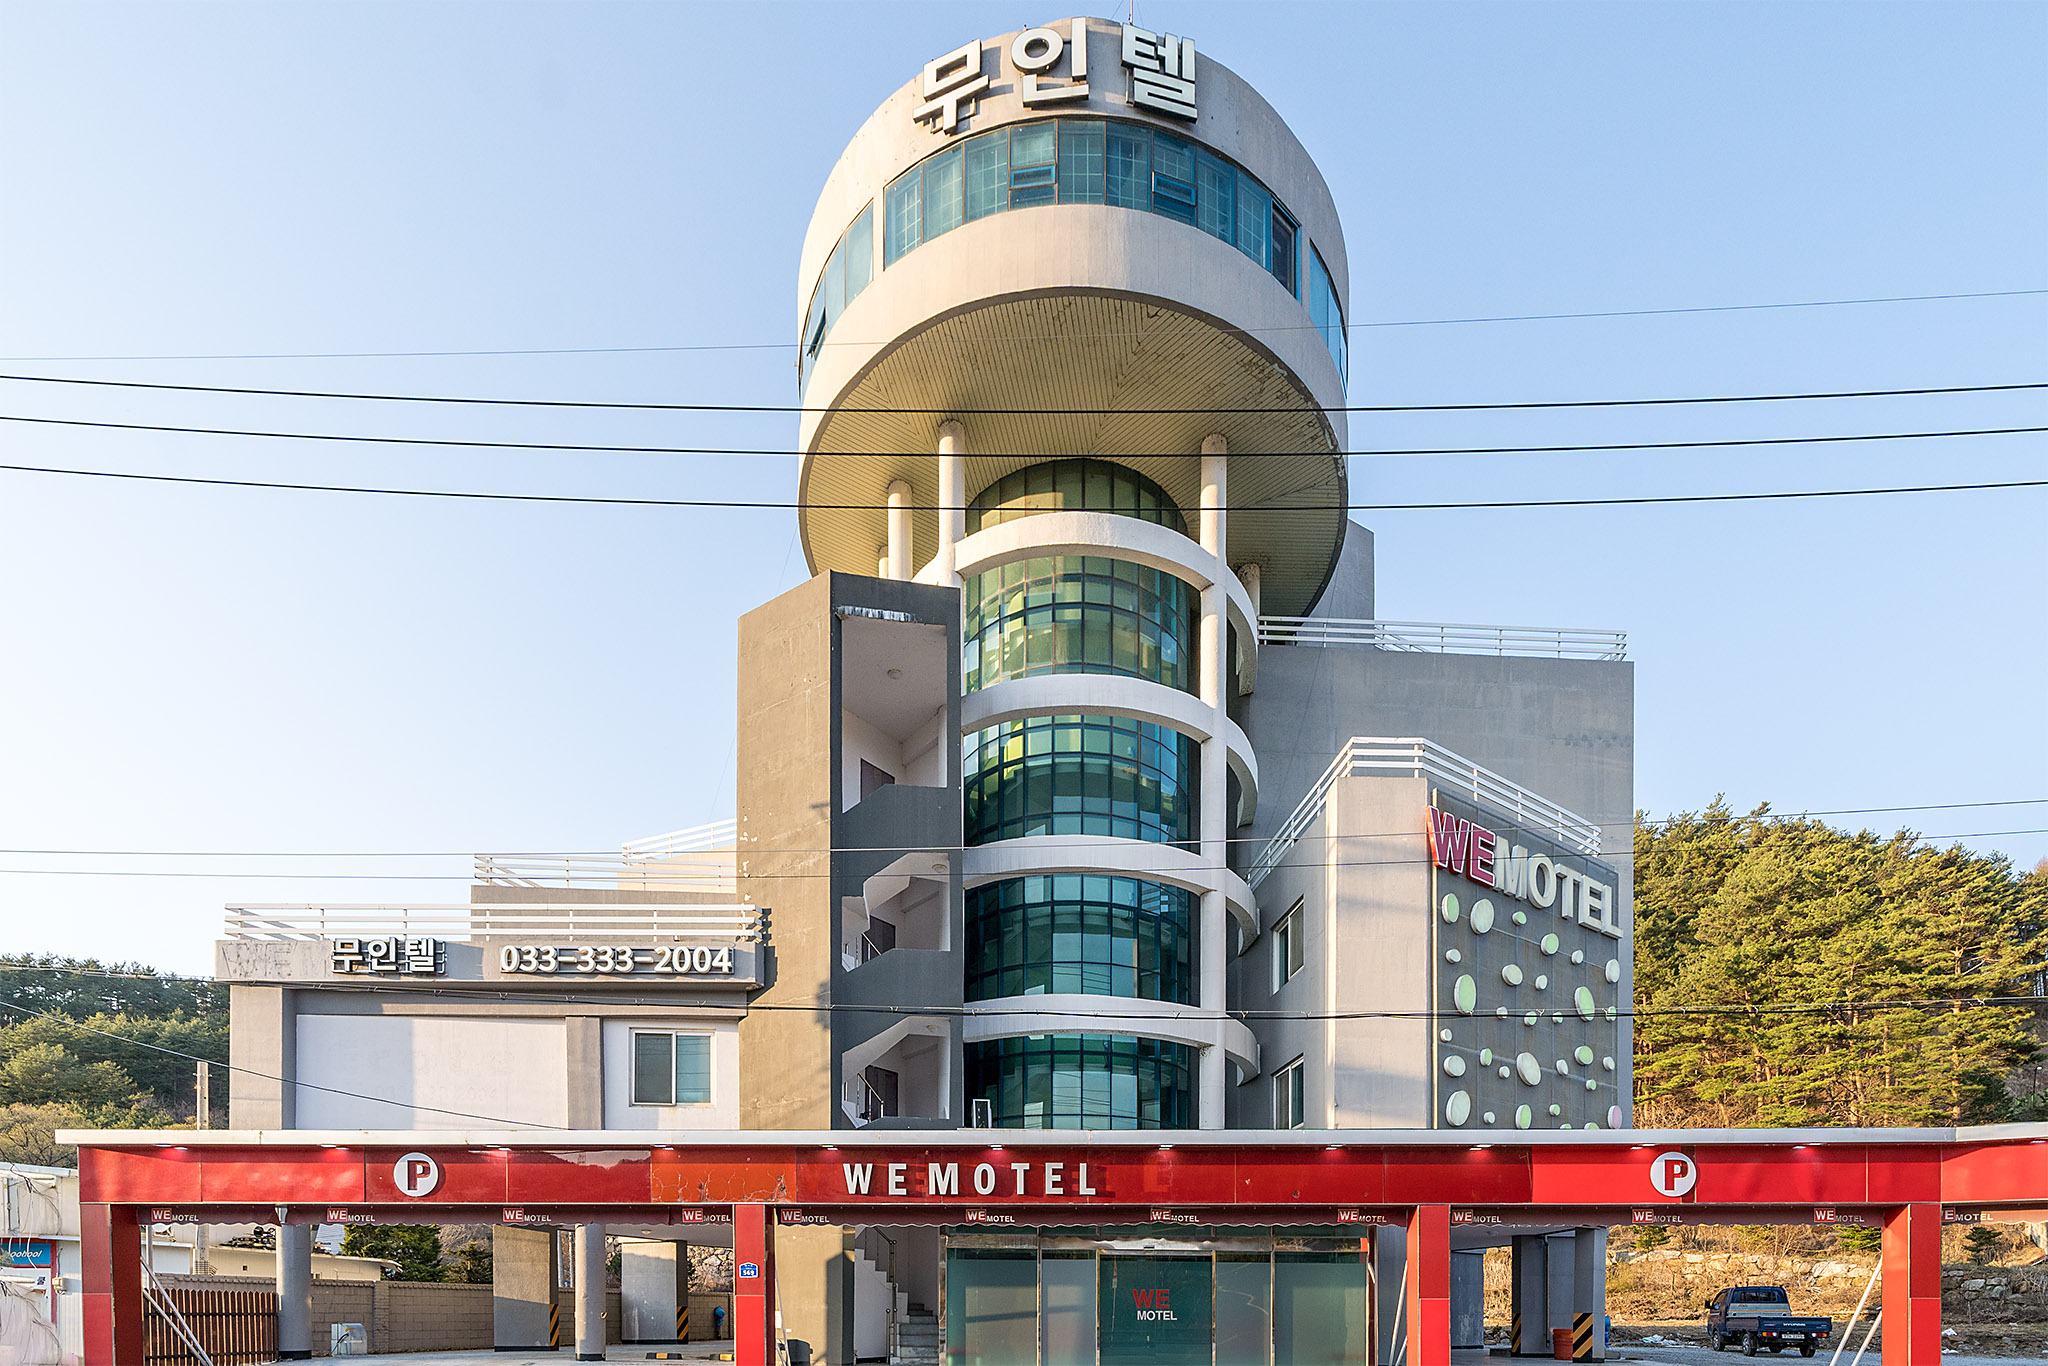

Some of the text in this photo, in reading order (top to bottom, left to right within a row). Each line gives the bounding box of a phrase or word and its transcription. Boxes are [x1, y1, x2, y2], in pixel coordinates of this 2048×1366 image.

[913, 17, 1198, 135] 무인텔
[1425, 805, 1623, 939] WE MOTEL
[332, 937, 436, 973] 무인텔
[499, 945, 733, 973] 033-333-2004
[407, 1160, 431, 1191] P
[842, 1162, 1097, 1196] WE MOTEL
[1664, 1159, 1689, 1191] P
[152, 1209, 199, 1222] WE MOTEL
[328, 1209, 375, 1222] WE MOTEL
[504, 1209, 551, 1222] WE MOTEL
[683, 1210, 731, 1222] WE MOTEL
[781, 1210, 830, 1223] WE MOTEL
[966, 1210, 1015, 1223] WE MOTEL
[1151, 1210, 1171, 1221] WE
[1339, 1210, 1387, 1223] WE MOTEL
[1453, 1210, 1501, 1223] WE MOTEL
[1633, 1210, 1683, 1223] WE MOTEL
[1815, 1209, 1835, 1221] WE
[1955, 1213, 1993, 1221] MOTEL
[1132, 1289, 1170, 1309] WE
[1137, 1310, 1178, 1321] MOTEL
